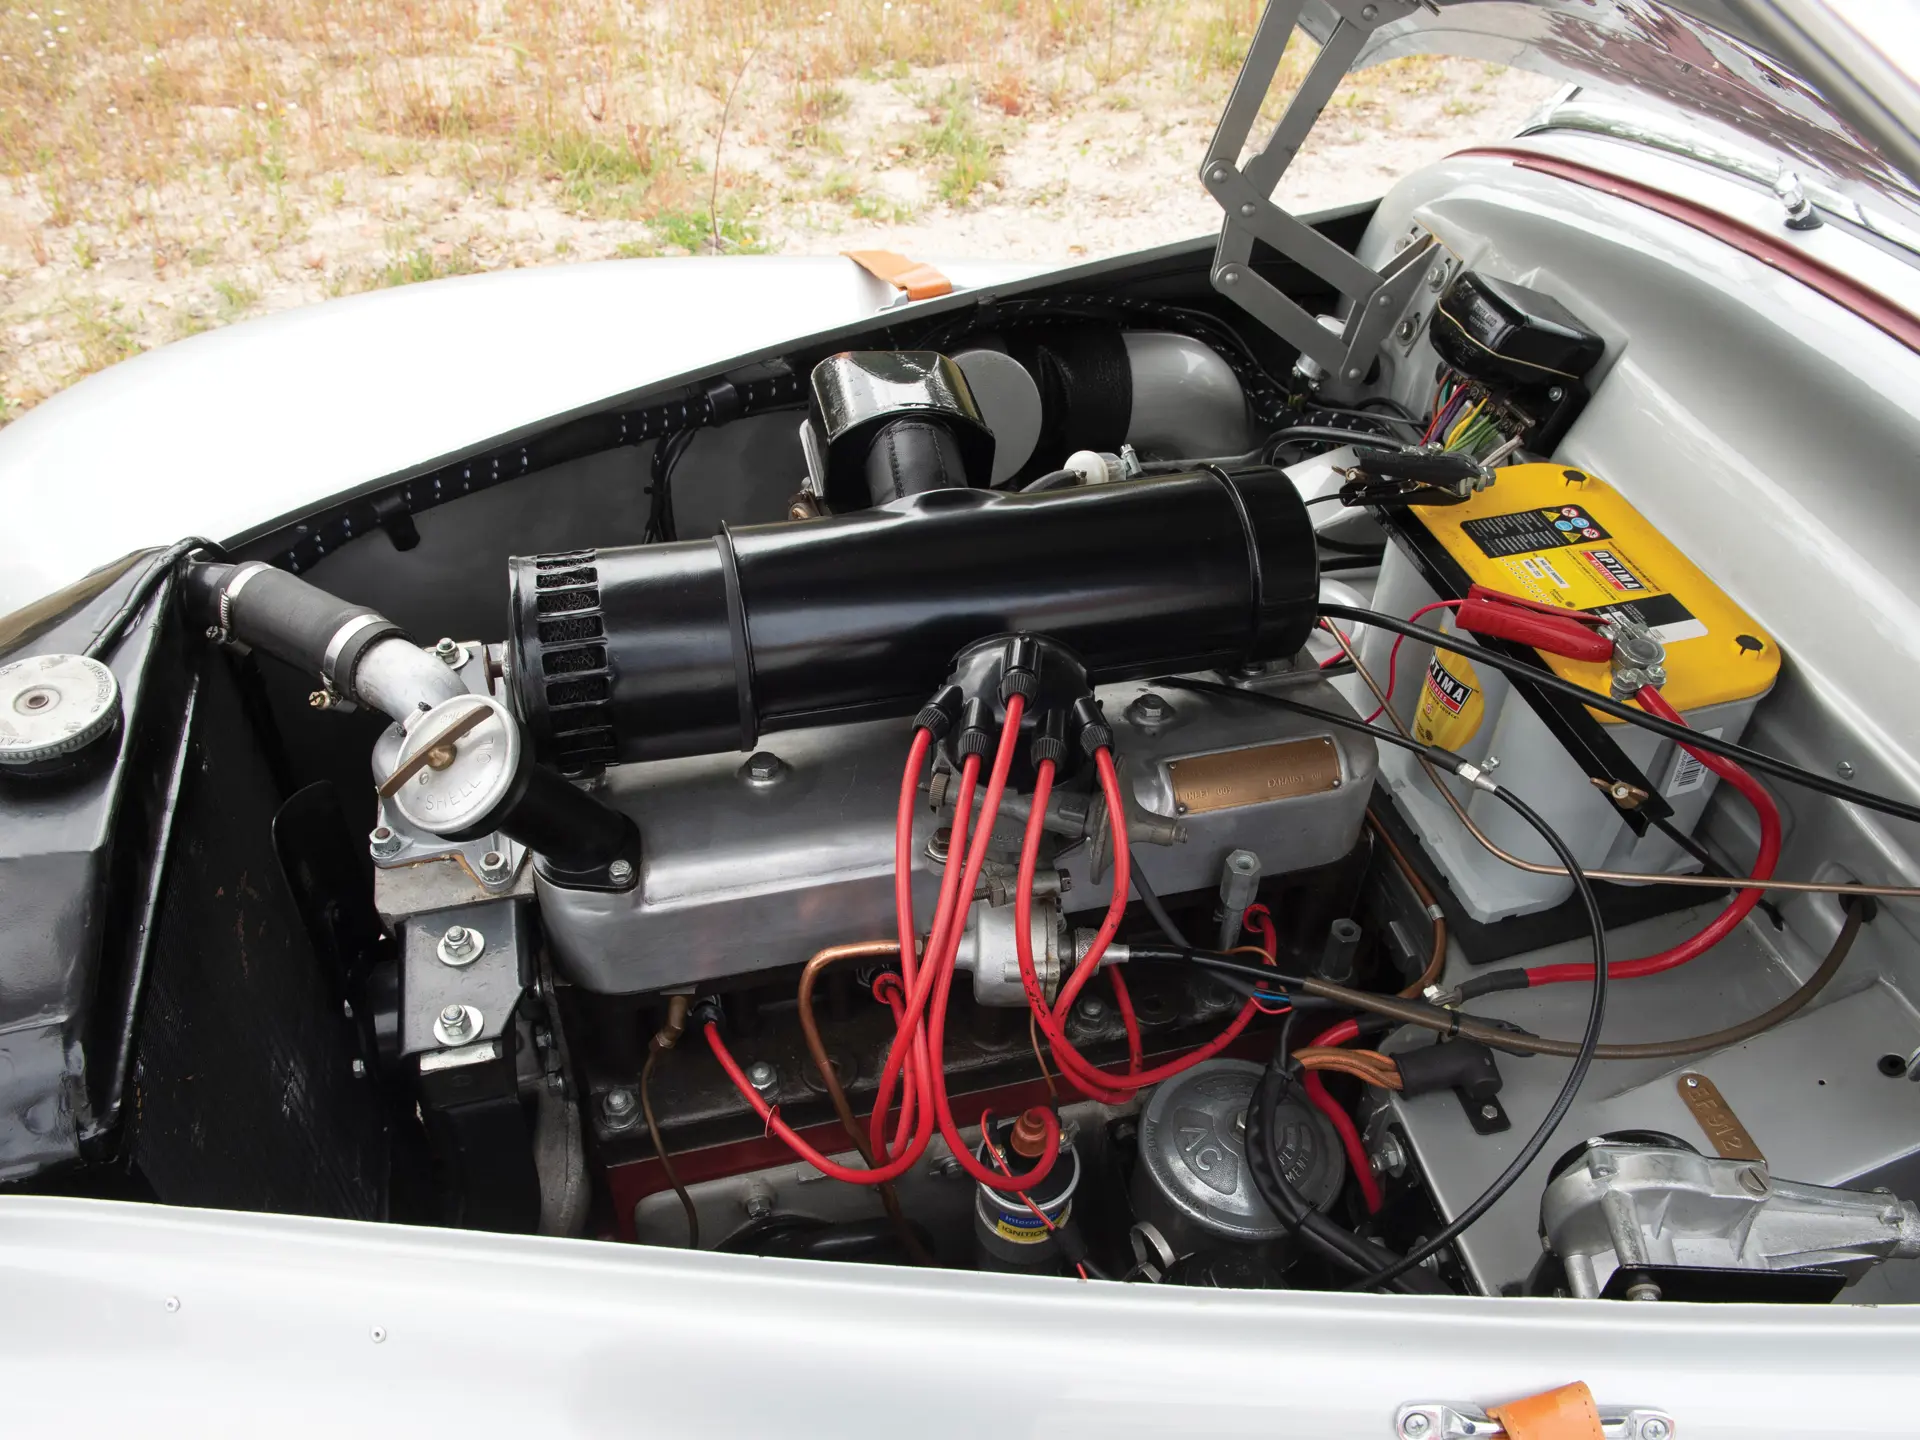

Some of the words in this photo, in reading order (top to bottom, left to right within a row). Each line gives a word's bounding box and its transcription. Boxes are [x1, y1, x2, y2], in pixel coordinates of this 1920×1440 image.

[1594, 551, 1641, 589] OPTIMA
[1429, 655, 1464, 702] PTIMA
[425, 780, 481, 811] SHELL
[476, 736, 494, 764] OIL
[1267, 773, 1304, 788] EXHAUST
[1179, 1126, 1222, 1171] AC
